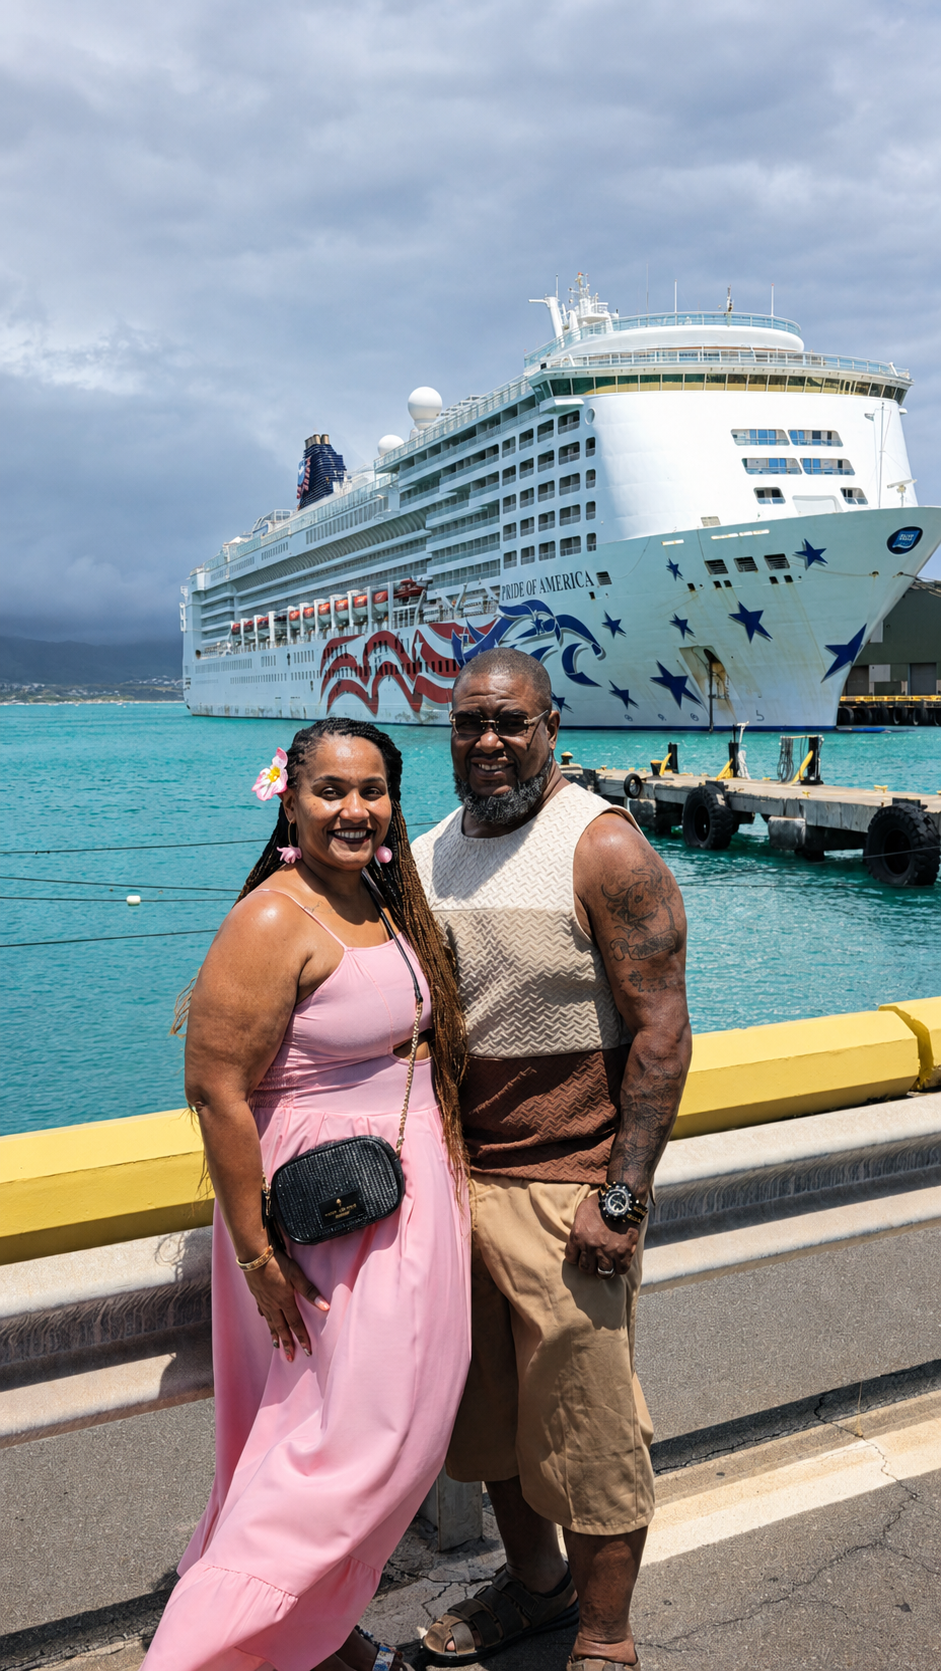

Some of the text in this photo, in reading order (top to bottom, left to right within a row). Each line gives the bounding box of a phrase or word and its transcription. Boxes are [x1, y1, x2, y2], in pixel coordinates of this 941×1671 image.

[501, 569, 595, 601] PRIDE OF AMERICA
